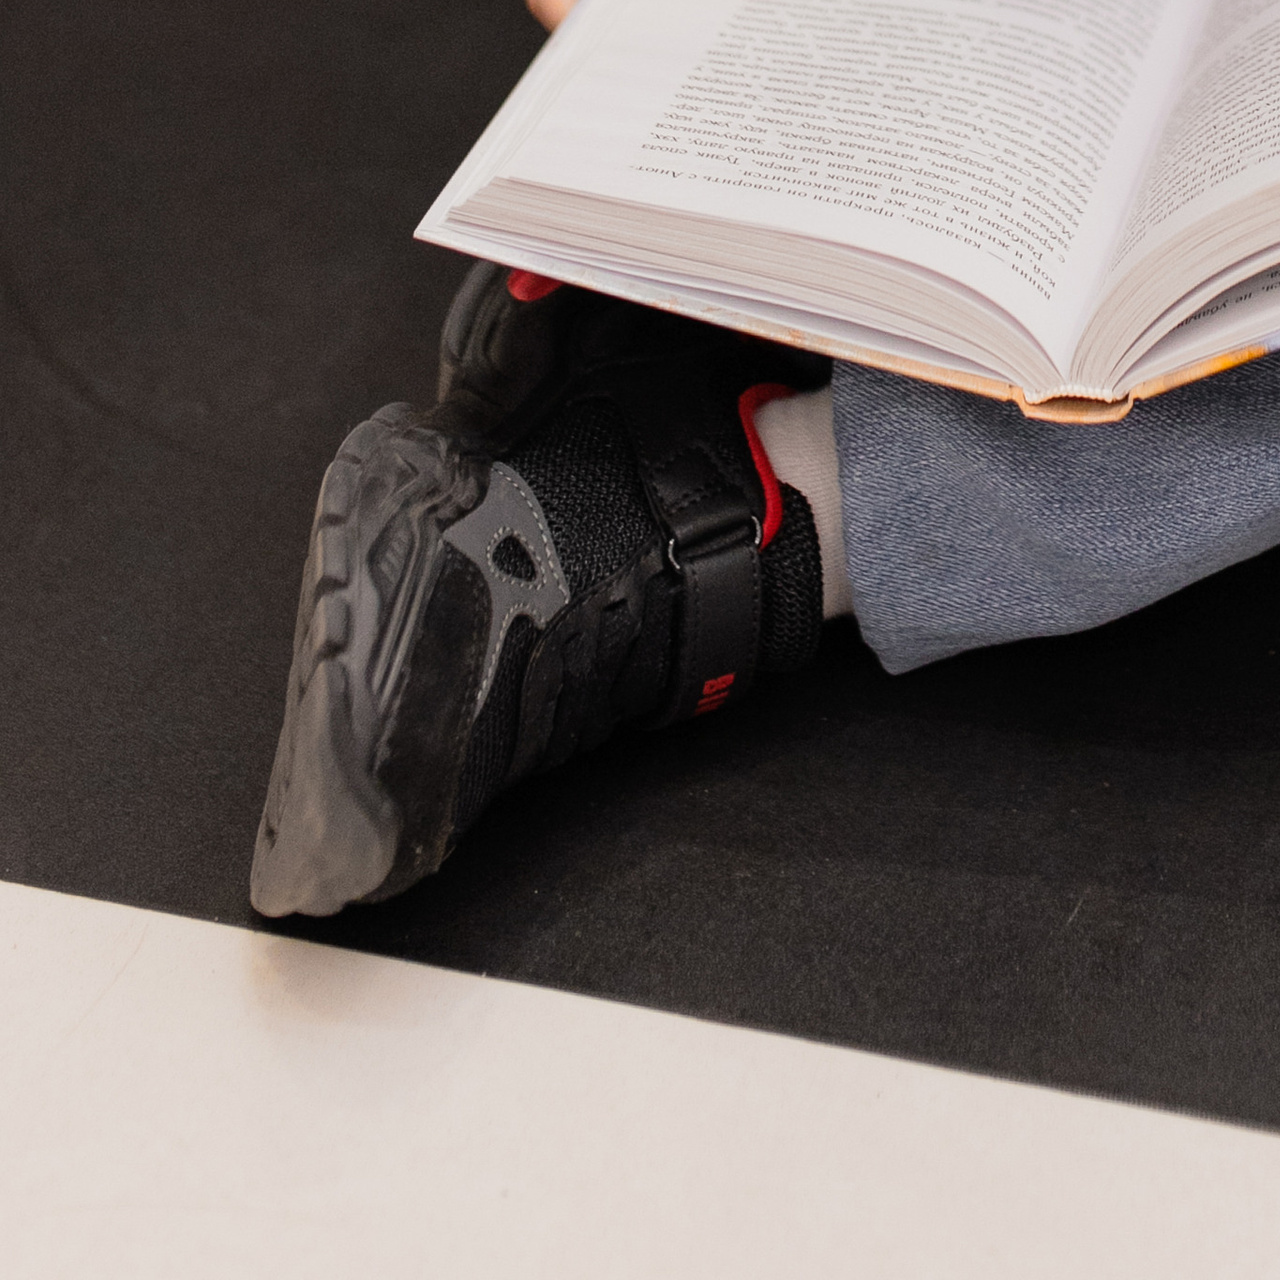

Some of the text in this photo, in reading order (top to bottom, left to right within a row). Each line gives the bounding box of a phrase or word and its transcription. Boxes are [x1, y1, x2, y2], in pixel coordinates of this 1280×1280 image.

[674, 93, 755, 111] привычно
[772, 97, 820, 110] замок.
[878, 102, 931, 120] Артем,
[710, 108, 746, 120] шел,
[753, 115, 794, 127] очки,
[758, 104, 829, 122] отпирал,
[825, 105, 889, 121] смазать
[739, 125, 769, 134] иду,
[798, 123, 891, 144] переносицу
[832, 116, 903, 135] затылок,
[892, 117, 943, 133] забыл
[936, 113, 987, 136] Маша,
[988, 118, 1035, 140] забыл
[689, 139, 729, 150] лапу,
[776, 130, 833, 145] брюки,
[903, 130, 966, 151] ломило
[642, 144, 689, 155] сполз
[697, 152, 739, 165] Тузик
[734, 147, 795, 161] правую
[839, 142, 919, 162] натягивая
[1039, 139, 1080, 167] вчера
[752, 160, 802, 174] дверь,
[919, 147, 995, 173] водружая
[1023, 157, 1058, 179] себя
[629, 165, 684, 179] Анют-
[740, 171, 837, 192] закончится.
[827, 163, 903, 182] припадая
[828, 174, 883, 189] звонок
[927, 159, 1016, 198] Георгиевич,
[655, 123, 1068, 249] забыли вчера лекарством намазать, закручинился
[703, 176, 782, 193] говорить
[890, 188, 947, 207] долгий
[912, 179, 988, 210] поплелся,
[814, 195, 894, 218] прекрати
[1027, 186, 1080, 228] крикнул
[1022, 197, 1075, 240] Максим
[902, 215, 982, 249] казалось,
[961, 222, 1010, 249] жизнь
[978, 216, 1044, 261] Разбудил
[996, 210, 1055, 253] кровати,
[1012, 264, 1051, 300] вания
[1030, 260, 1056, 288] кой,
[1235, 292, 1252, 303] не
